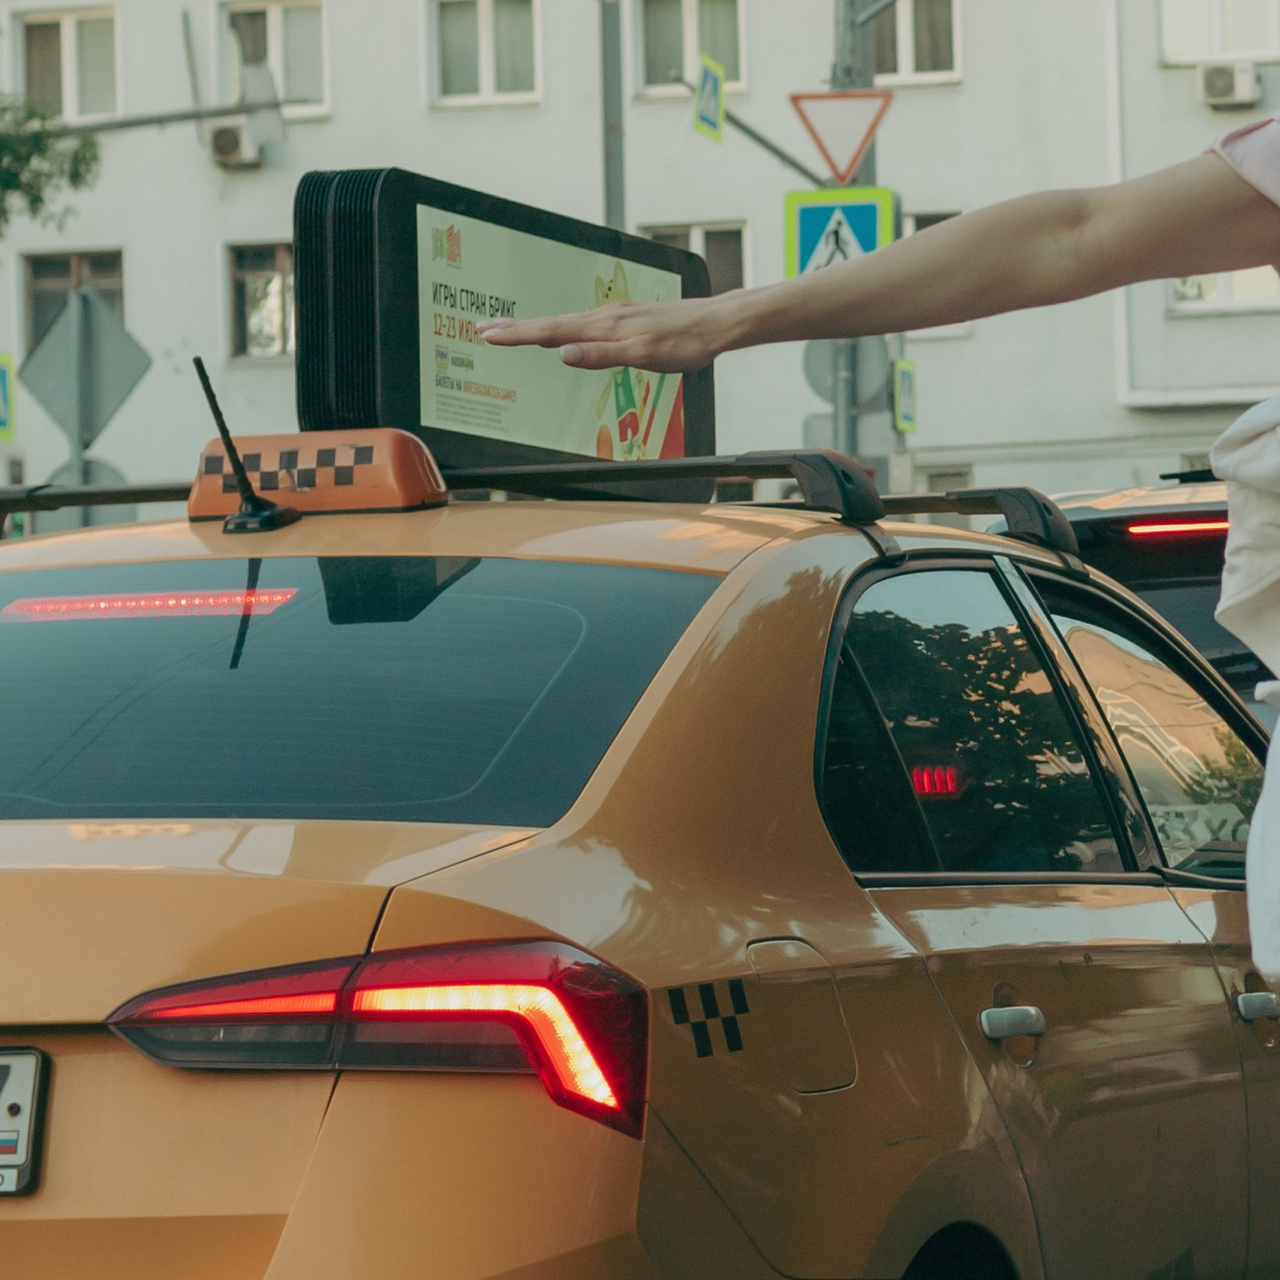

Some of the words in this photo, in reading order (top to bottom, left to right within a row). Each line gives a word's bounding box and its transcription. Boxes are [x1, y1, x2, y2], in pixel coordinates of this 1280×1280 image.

[432, 282, 457, 309] ИГРЫ
[460, 288, 487, 316] СТРАН
[434, 312, 456, 339] 12-23
